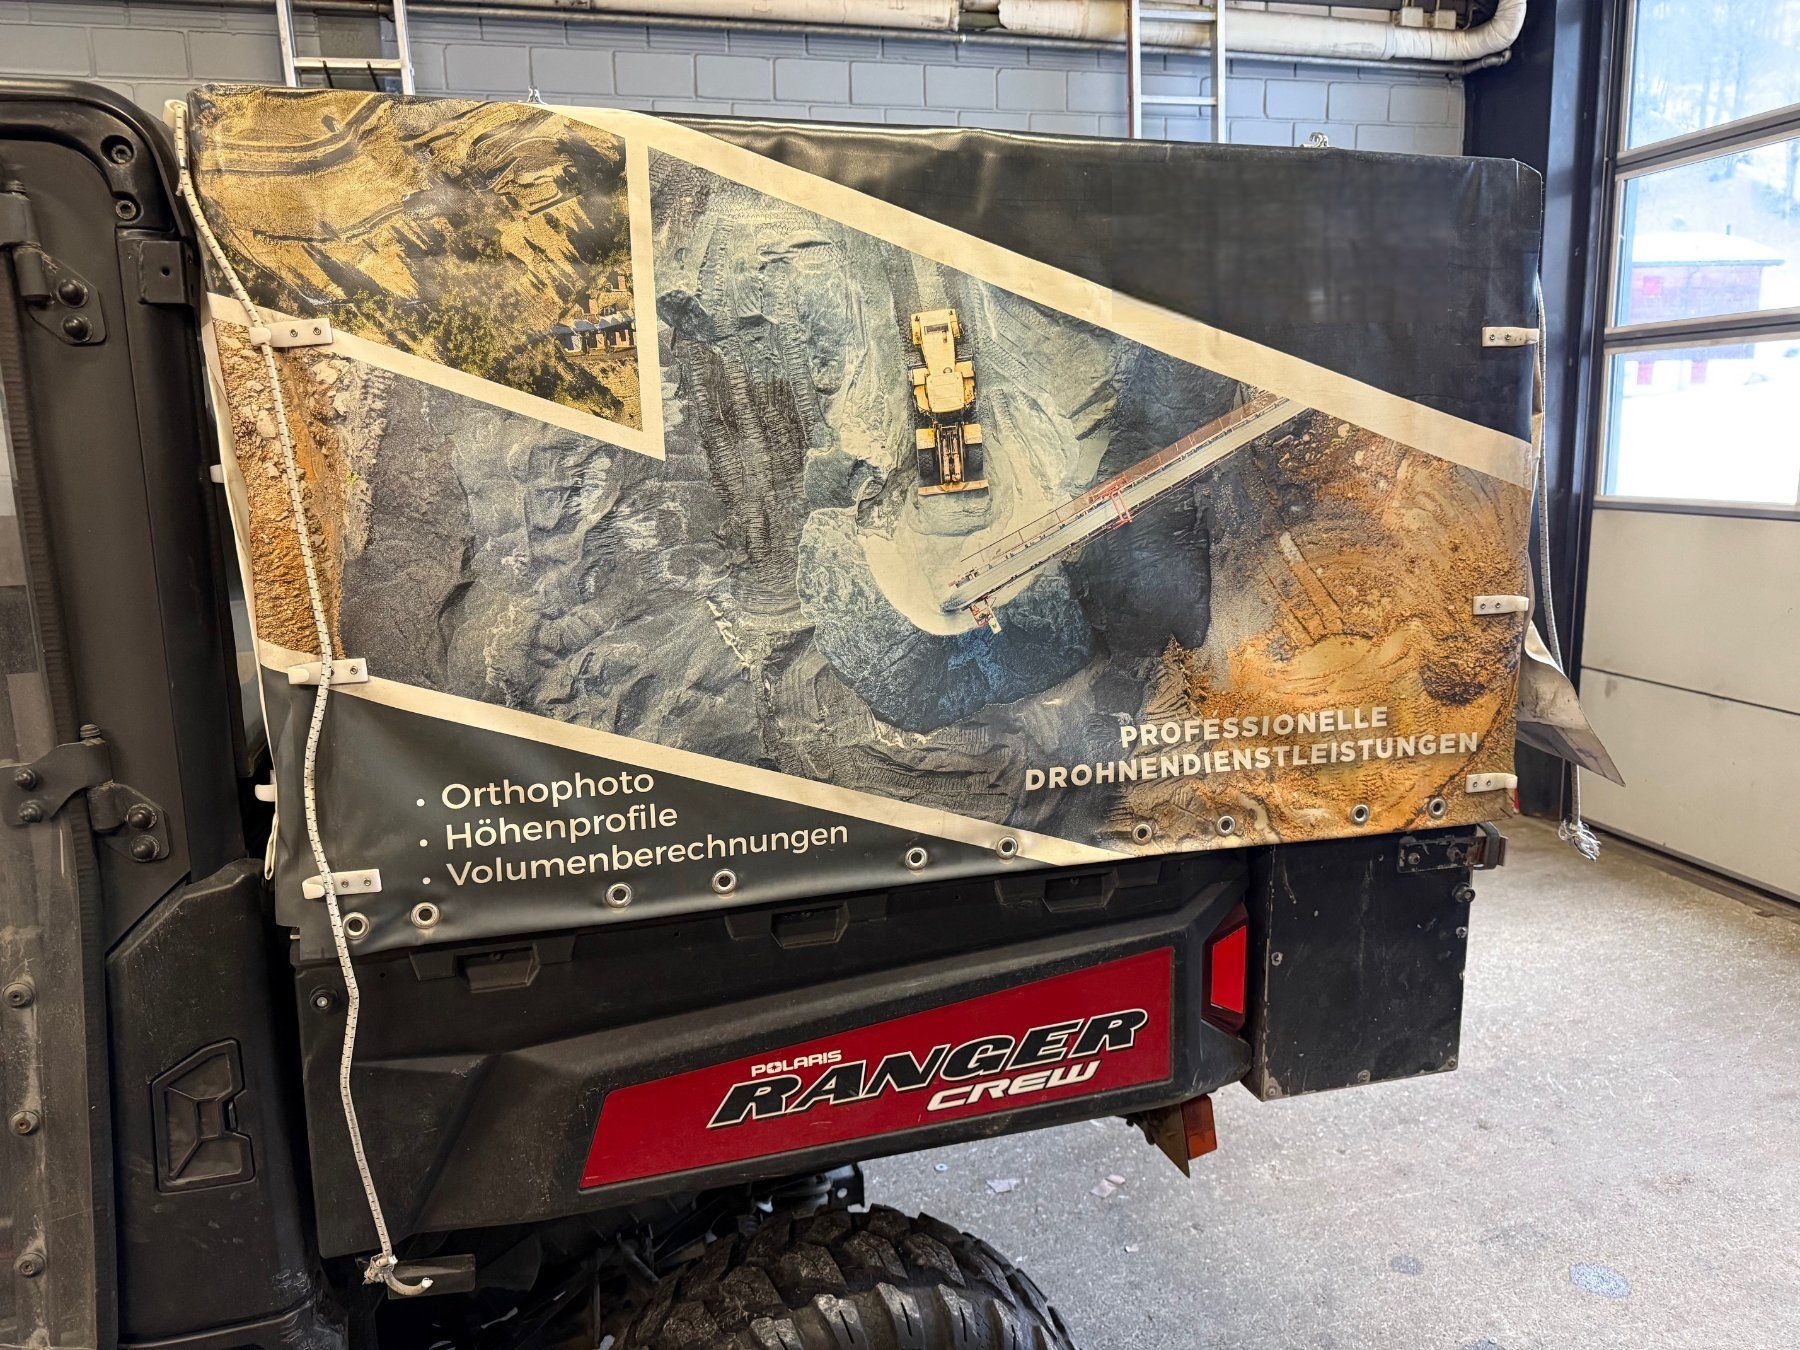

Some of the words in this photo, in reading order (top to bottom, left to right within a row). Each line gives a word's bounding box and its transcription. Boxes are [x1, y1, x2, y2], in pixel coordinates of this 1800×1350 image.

[1120, 706, 1388, 748] PROFESSIONELLE
[1025, 731, 1478, 791] DROHNENDIENSTLEISTUNGEN
[441, 771, 654, 810] Orthophoto
[446, 803, 678, 850] Höhenprofile
[445, 825, 848, 887] Volumenberechnungen
[706, 1008, 1148, 1129] RANGER
[751, 1050, 842, 1078] POLARIS
[927, 1060, 1101, 1112] CREW
